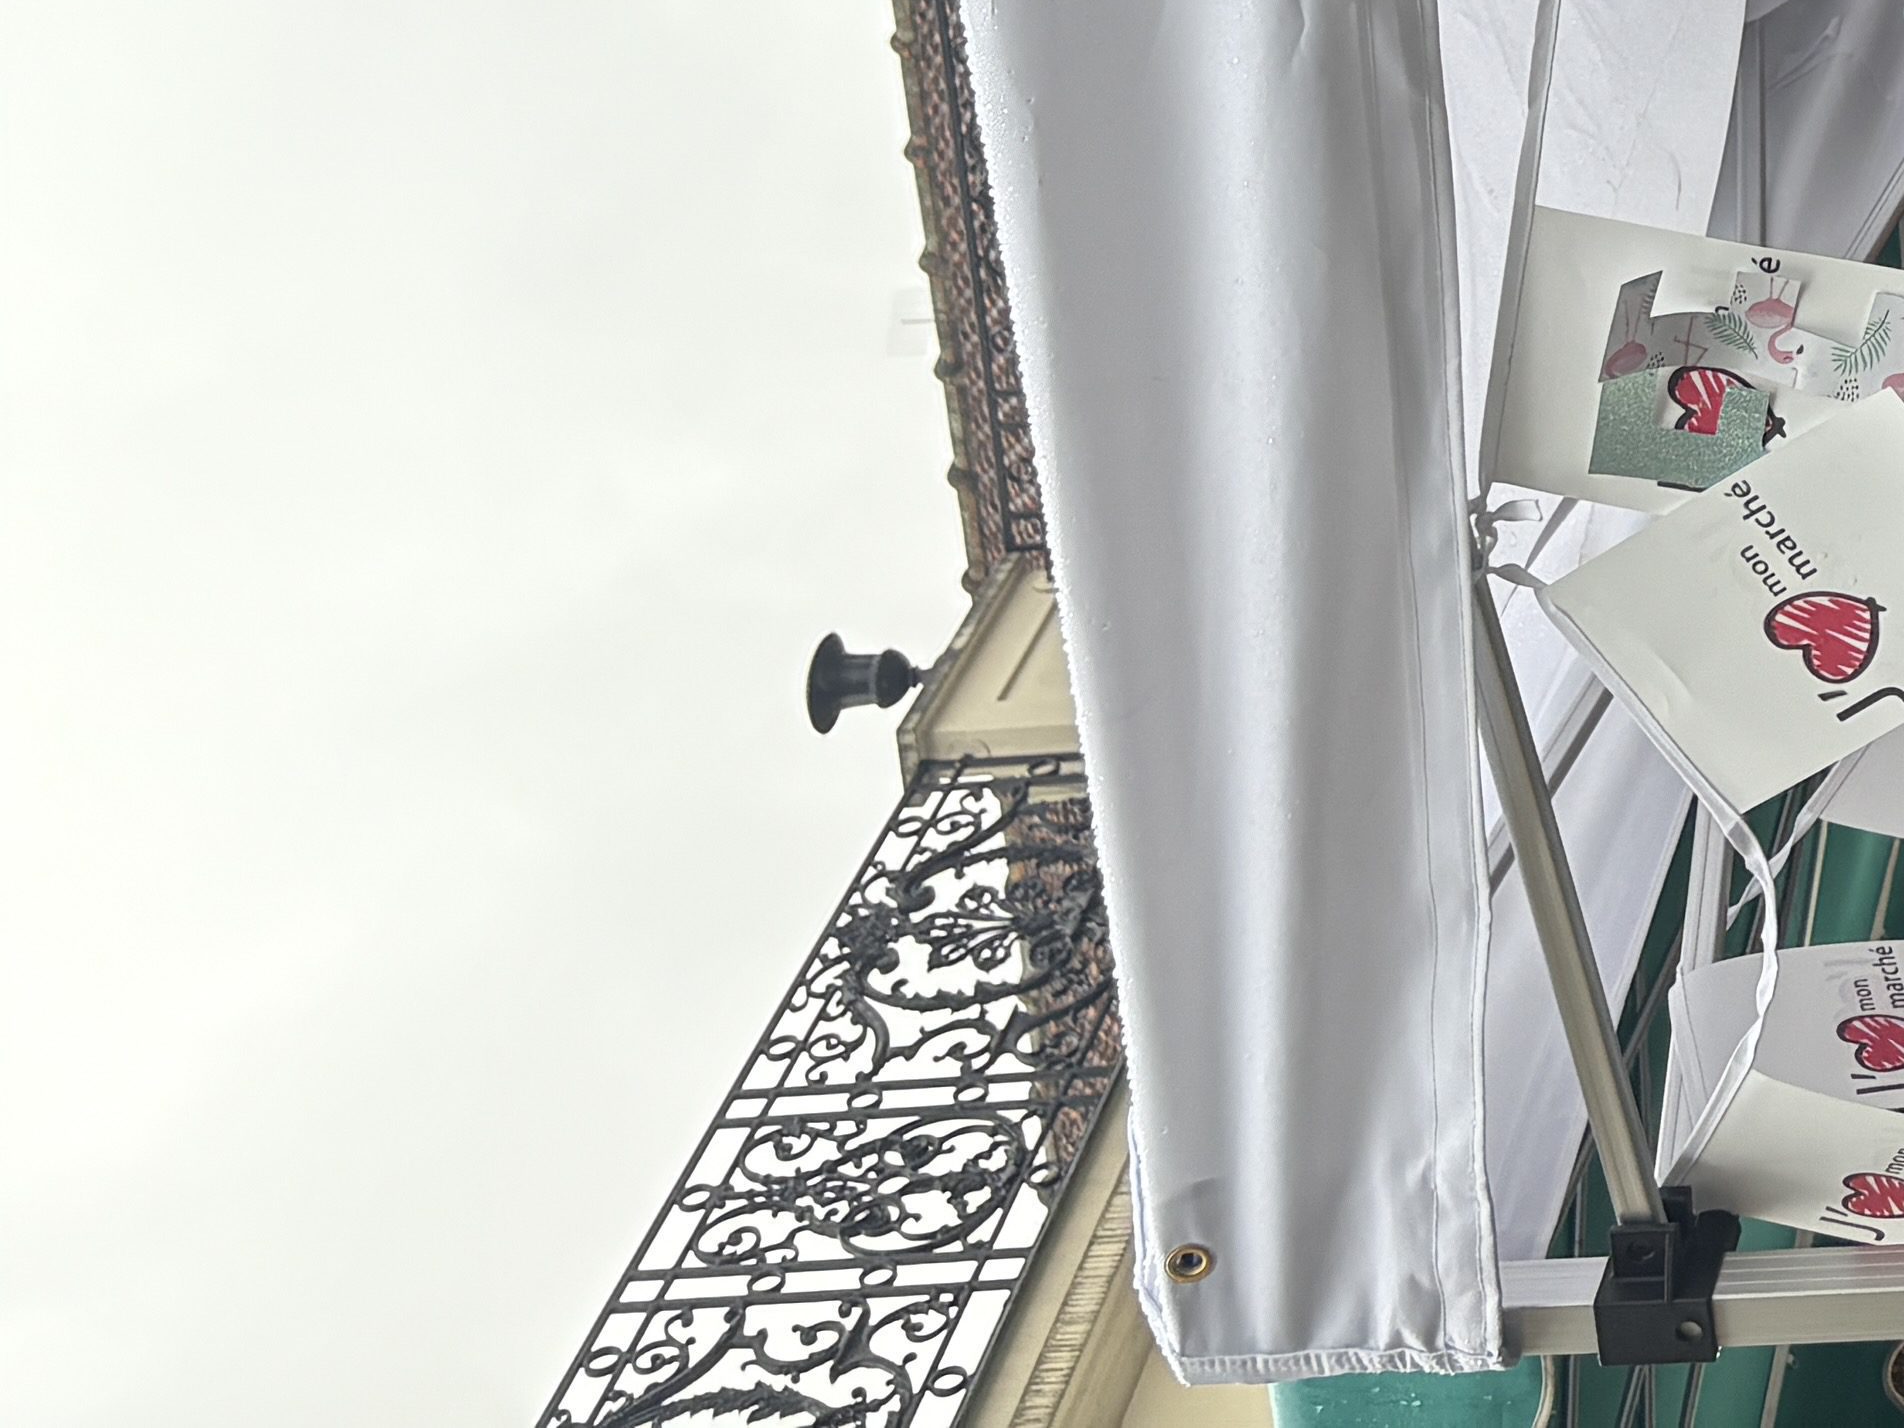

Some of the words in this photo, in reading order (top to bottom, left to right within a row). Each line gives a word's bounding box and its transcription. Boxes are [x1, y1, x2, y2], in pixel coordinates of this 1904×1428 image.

[1723, 478, 1818, 581] marché
[1738, 543, 1788, 597] mon
[1852, 978, 1877, 1012] mon
